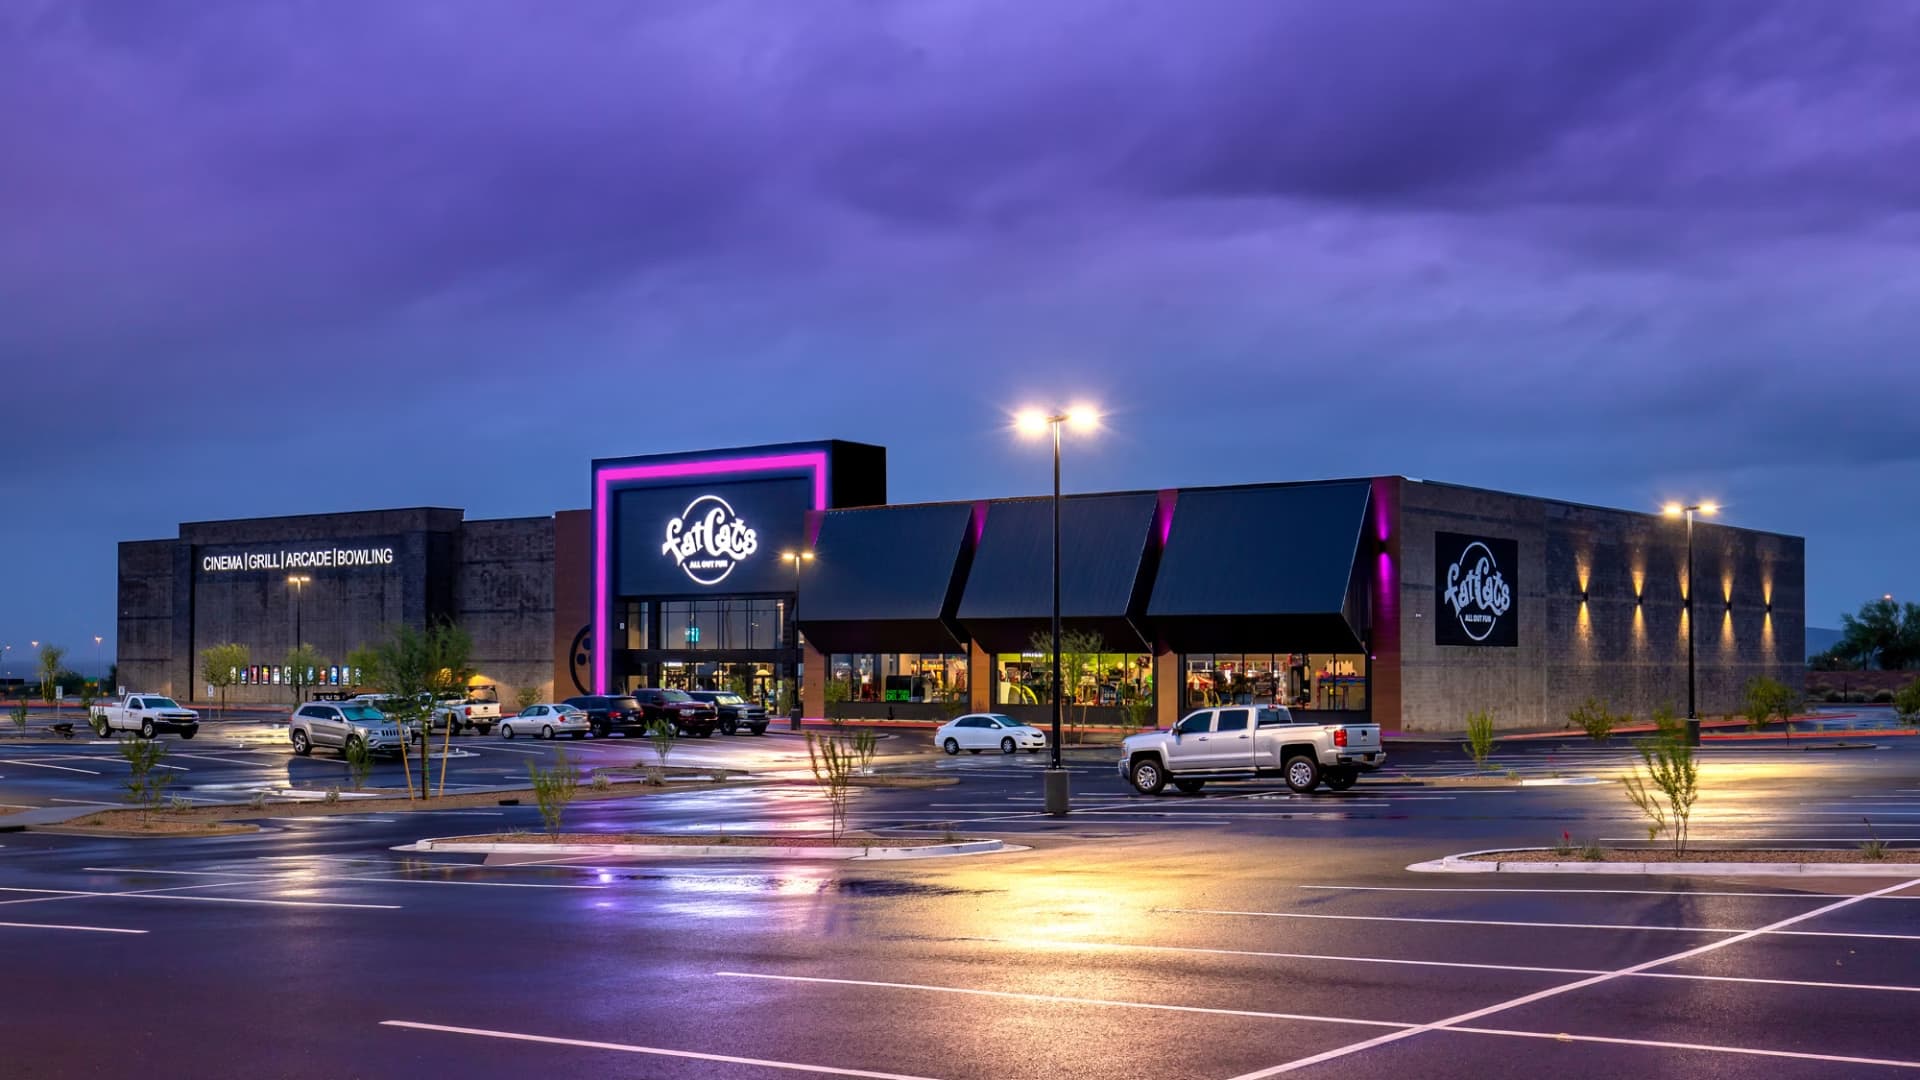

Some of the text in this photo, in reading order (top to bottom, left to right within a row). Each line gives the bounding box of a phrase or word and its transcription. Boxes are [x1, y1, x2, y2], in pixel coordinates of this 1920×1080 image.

[203, 548, 393, 571] CINEMA GRILL ARCADE BOWLING
[689, 559, 728, 569] ALL OUT FUN
[1465, 614, 1473, 622] ALL
